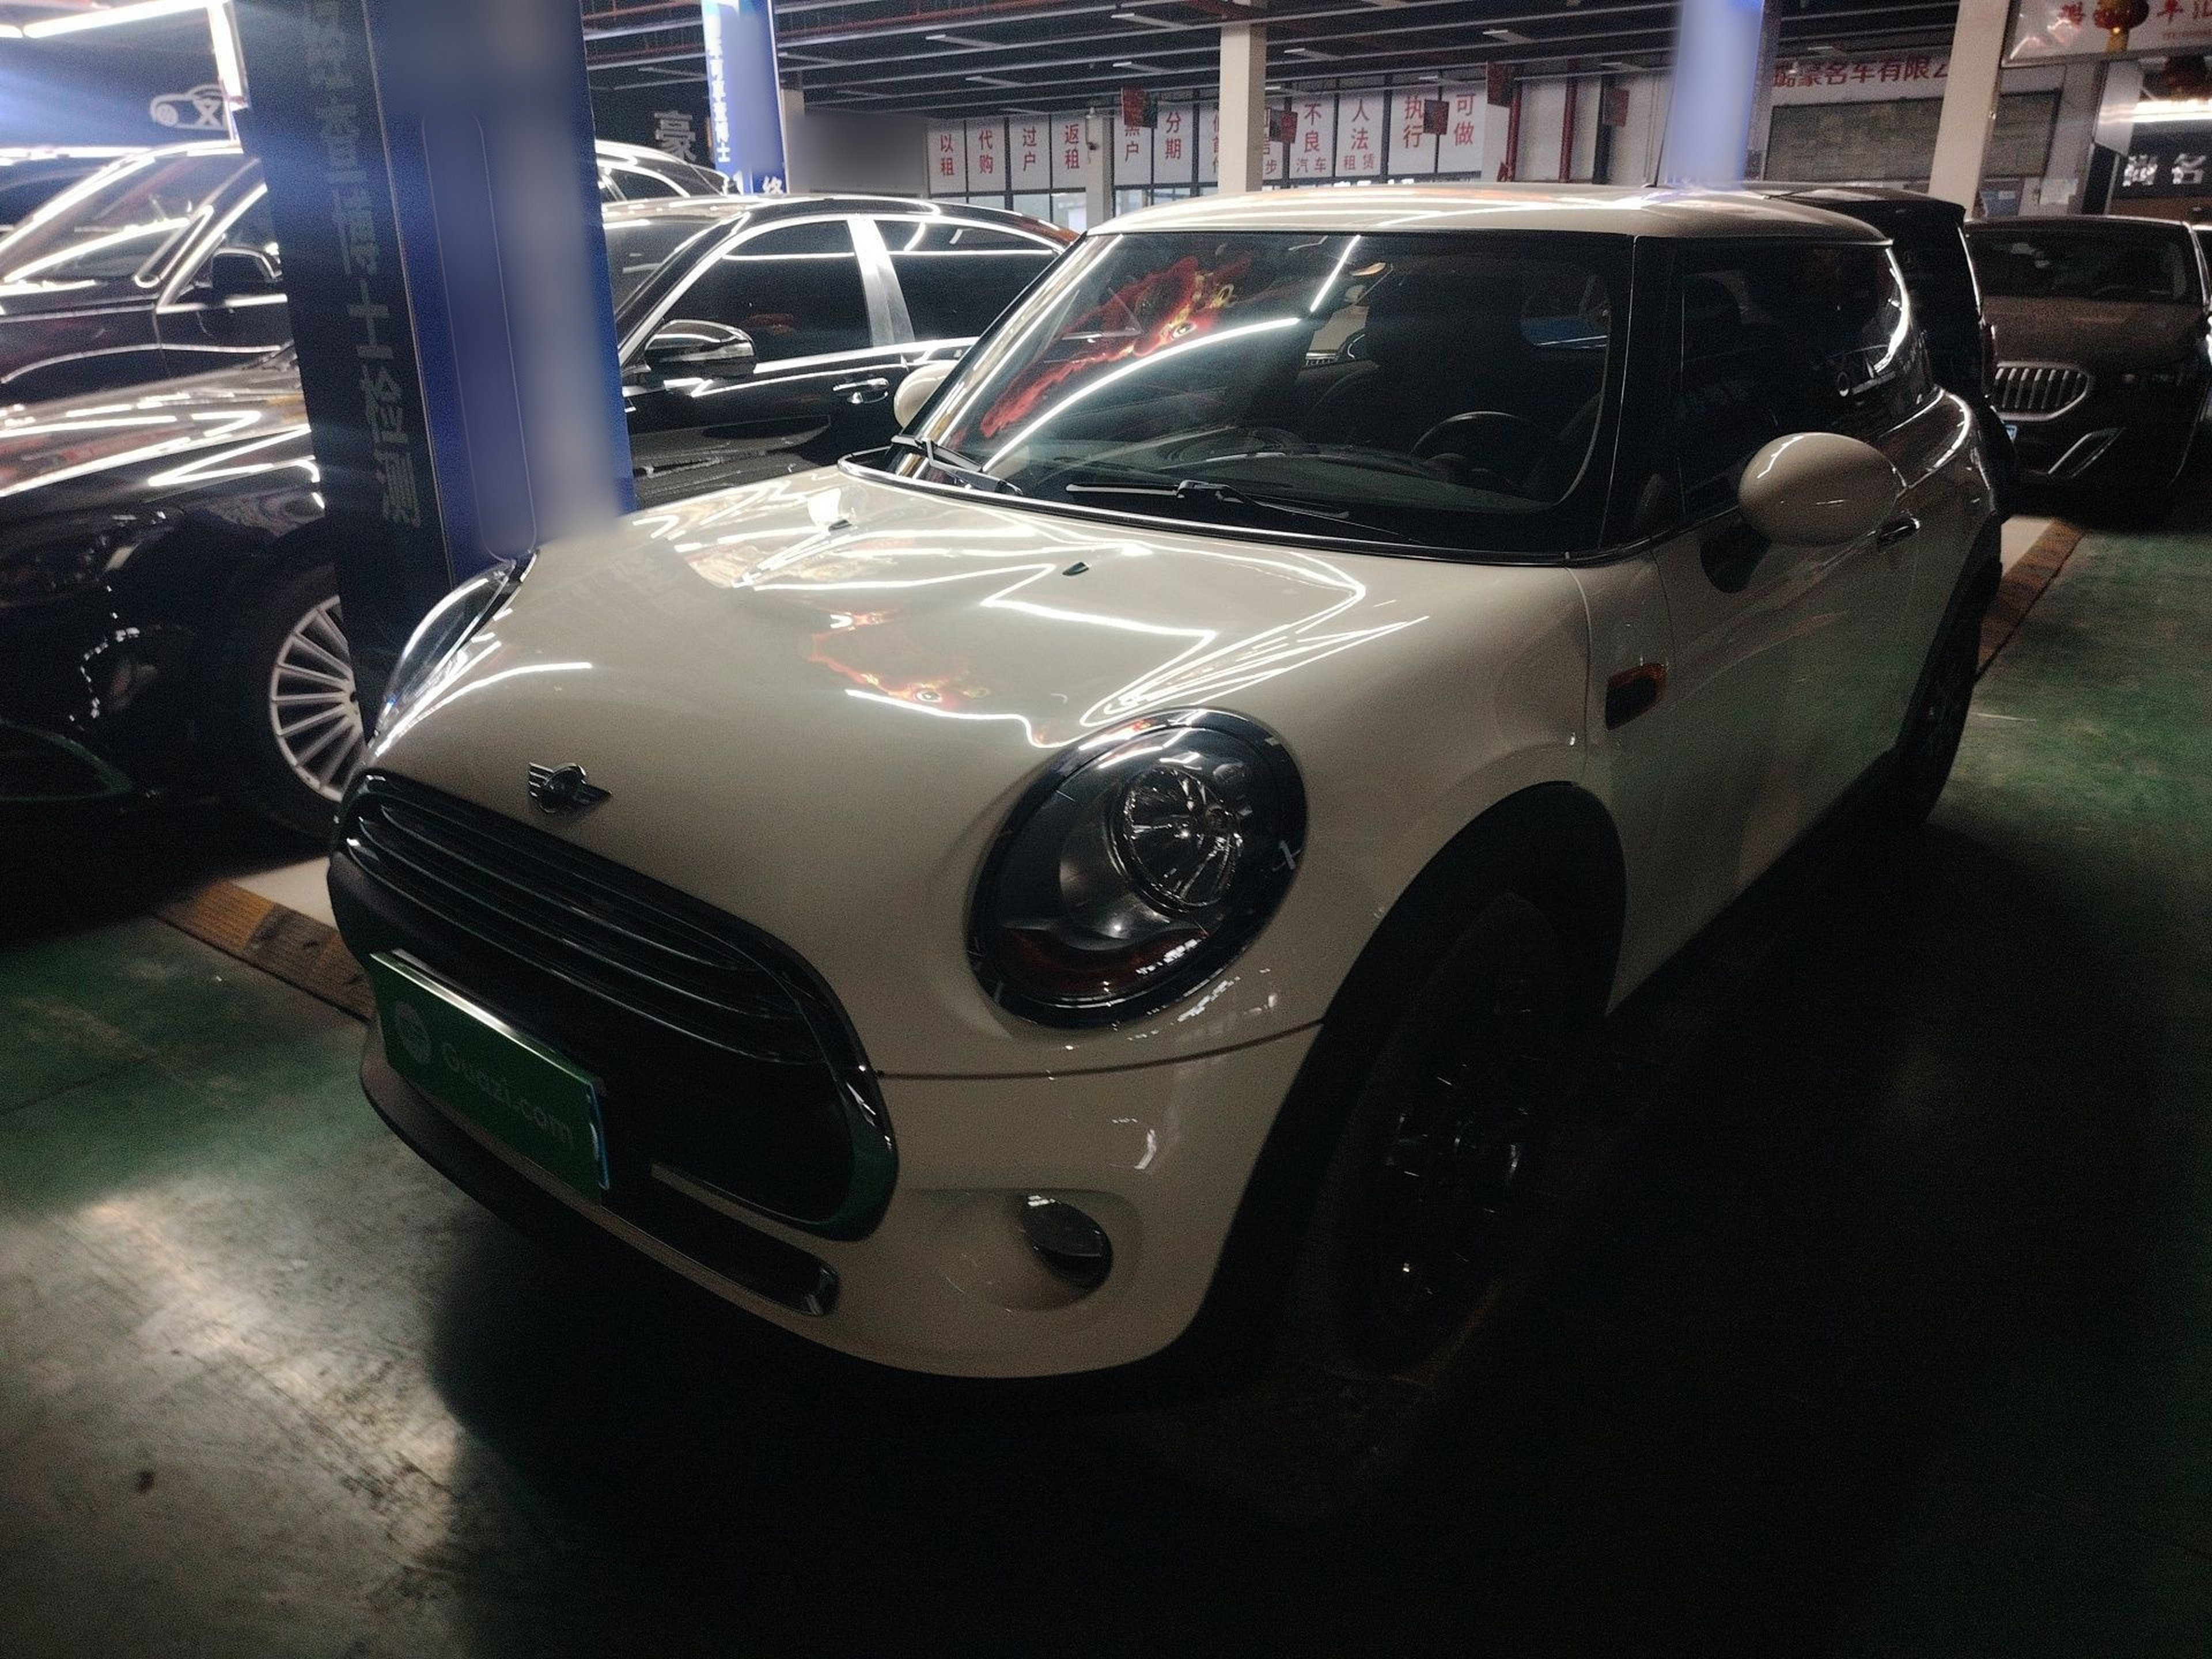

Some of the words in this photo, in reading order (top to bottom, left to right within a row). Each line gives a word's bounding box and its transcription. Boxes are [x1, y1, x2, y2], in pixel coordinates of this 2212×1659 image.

[654, 111, 696, 162] 豪
[1453, 93, 1476, 147] 可做
[940, 134, 955, 176] 以租
[978, 130, 994, 174] 代购
[1022, 126, 1036, 172] 过户
[1065, 123, 1080, 170] 返租
[441, 1040, 575, 1152] Guazi.com
